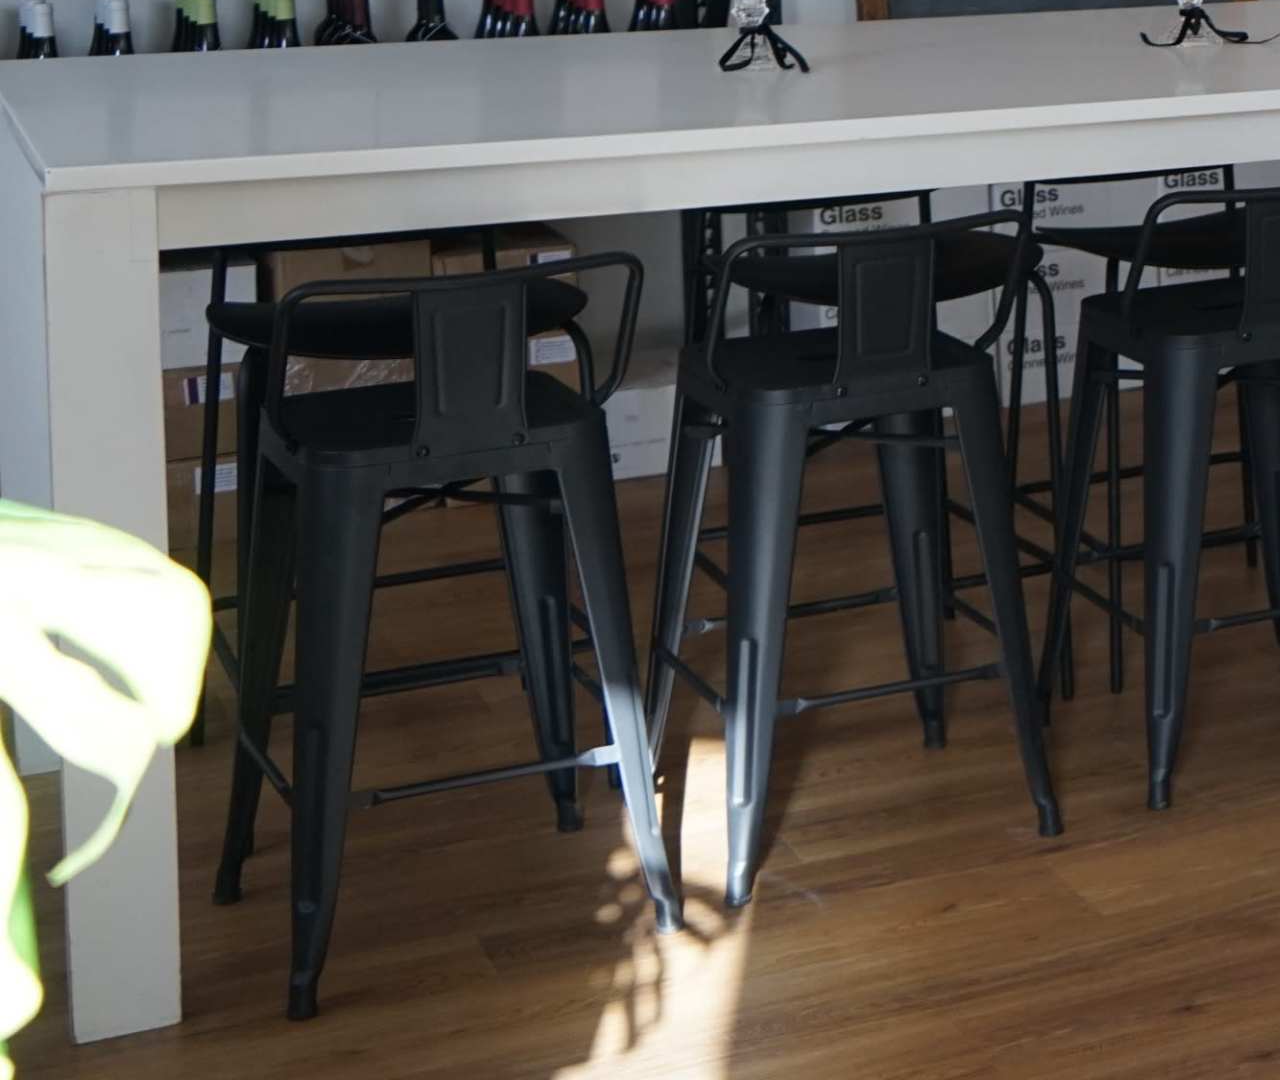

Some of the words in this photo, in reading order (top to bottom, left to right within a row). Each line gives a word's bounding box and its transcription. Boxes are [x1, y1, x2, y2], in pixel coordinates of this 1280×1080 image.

[1164, 170, 1220, 188] Glass
[1000, 187, 1059, 208] Glss
[820, 205, 883, 225] Glass
[1049, 204, 1084, 217] Wines
[1007, 335, 1066, 355] Glas
